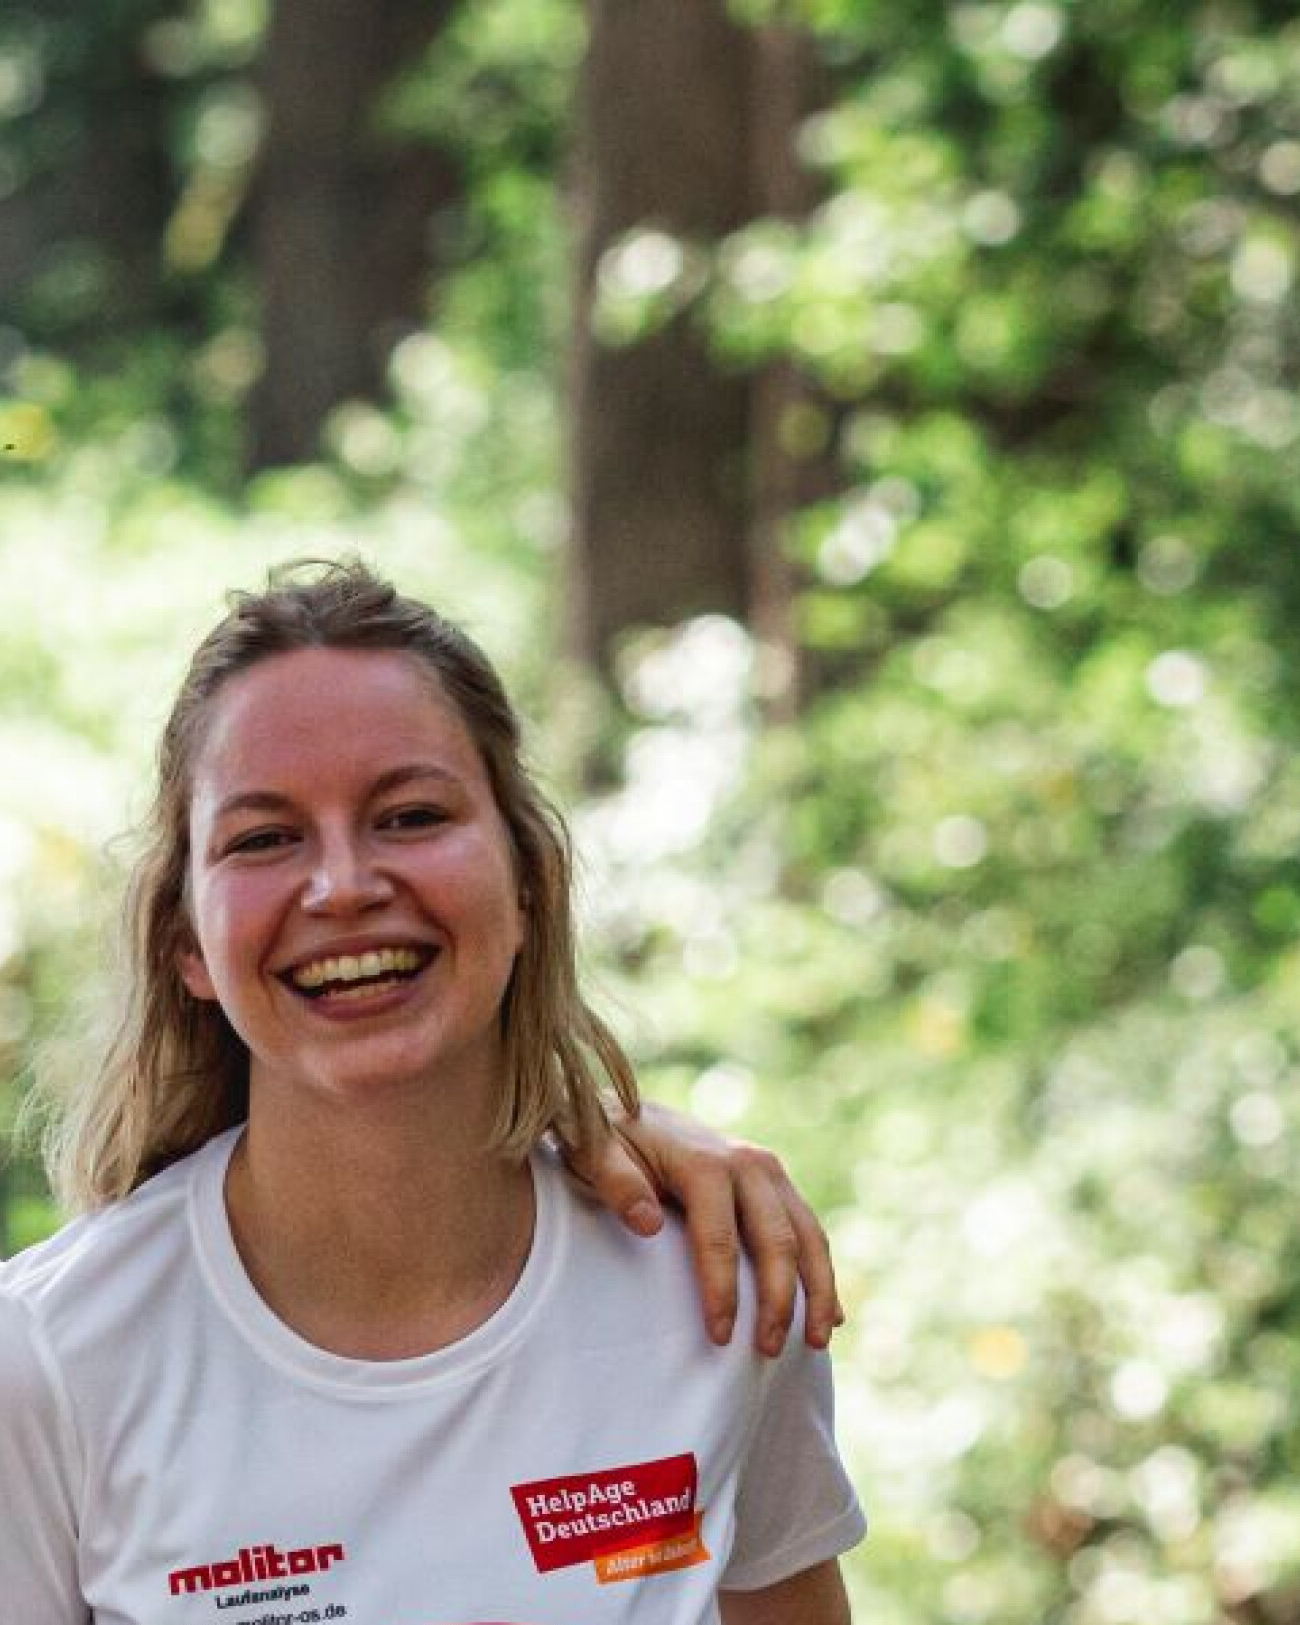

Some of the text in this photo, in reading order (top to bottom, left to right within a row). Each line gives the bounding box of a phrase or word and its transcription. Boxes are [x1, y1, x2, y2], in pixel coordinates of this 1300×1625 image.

[526, 1480, 636, 1517] HelpAge
[536, 1486, 691, 1544] Deutschland
[168, 1543, 344, 1595] molitor
